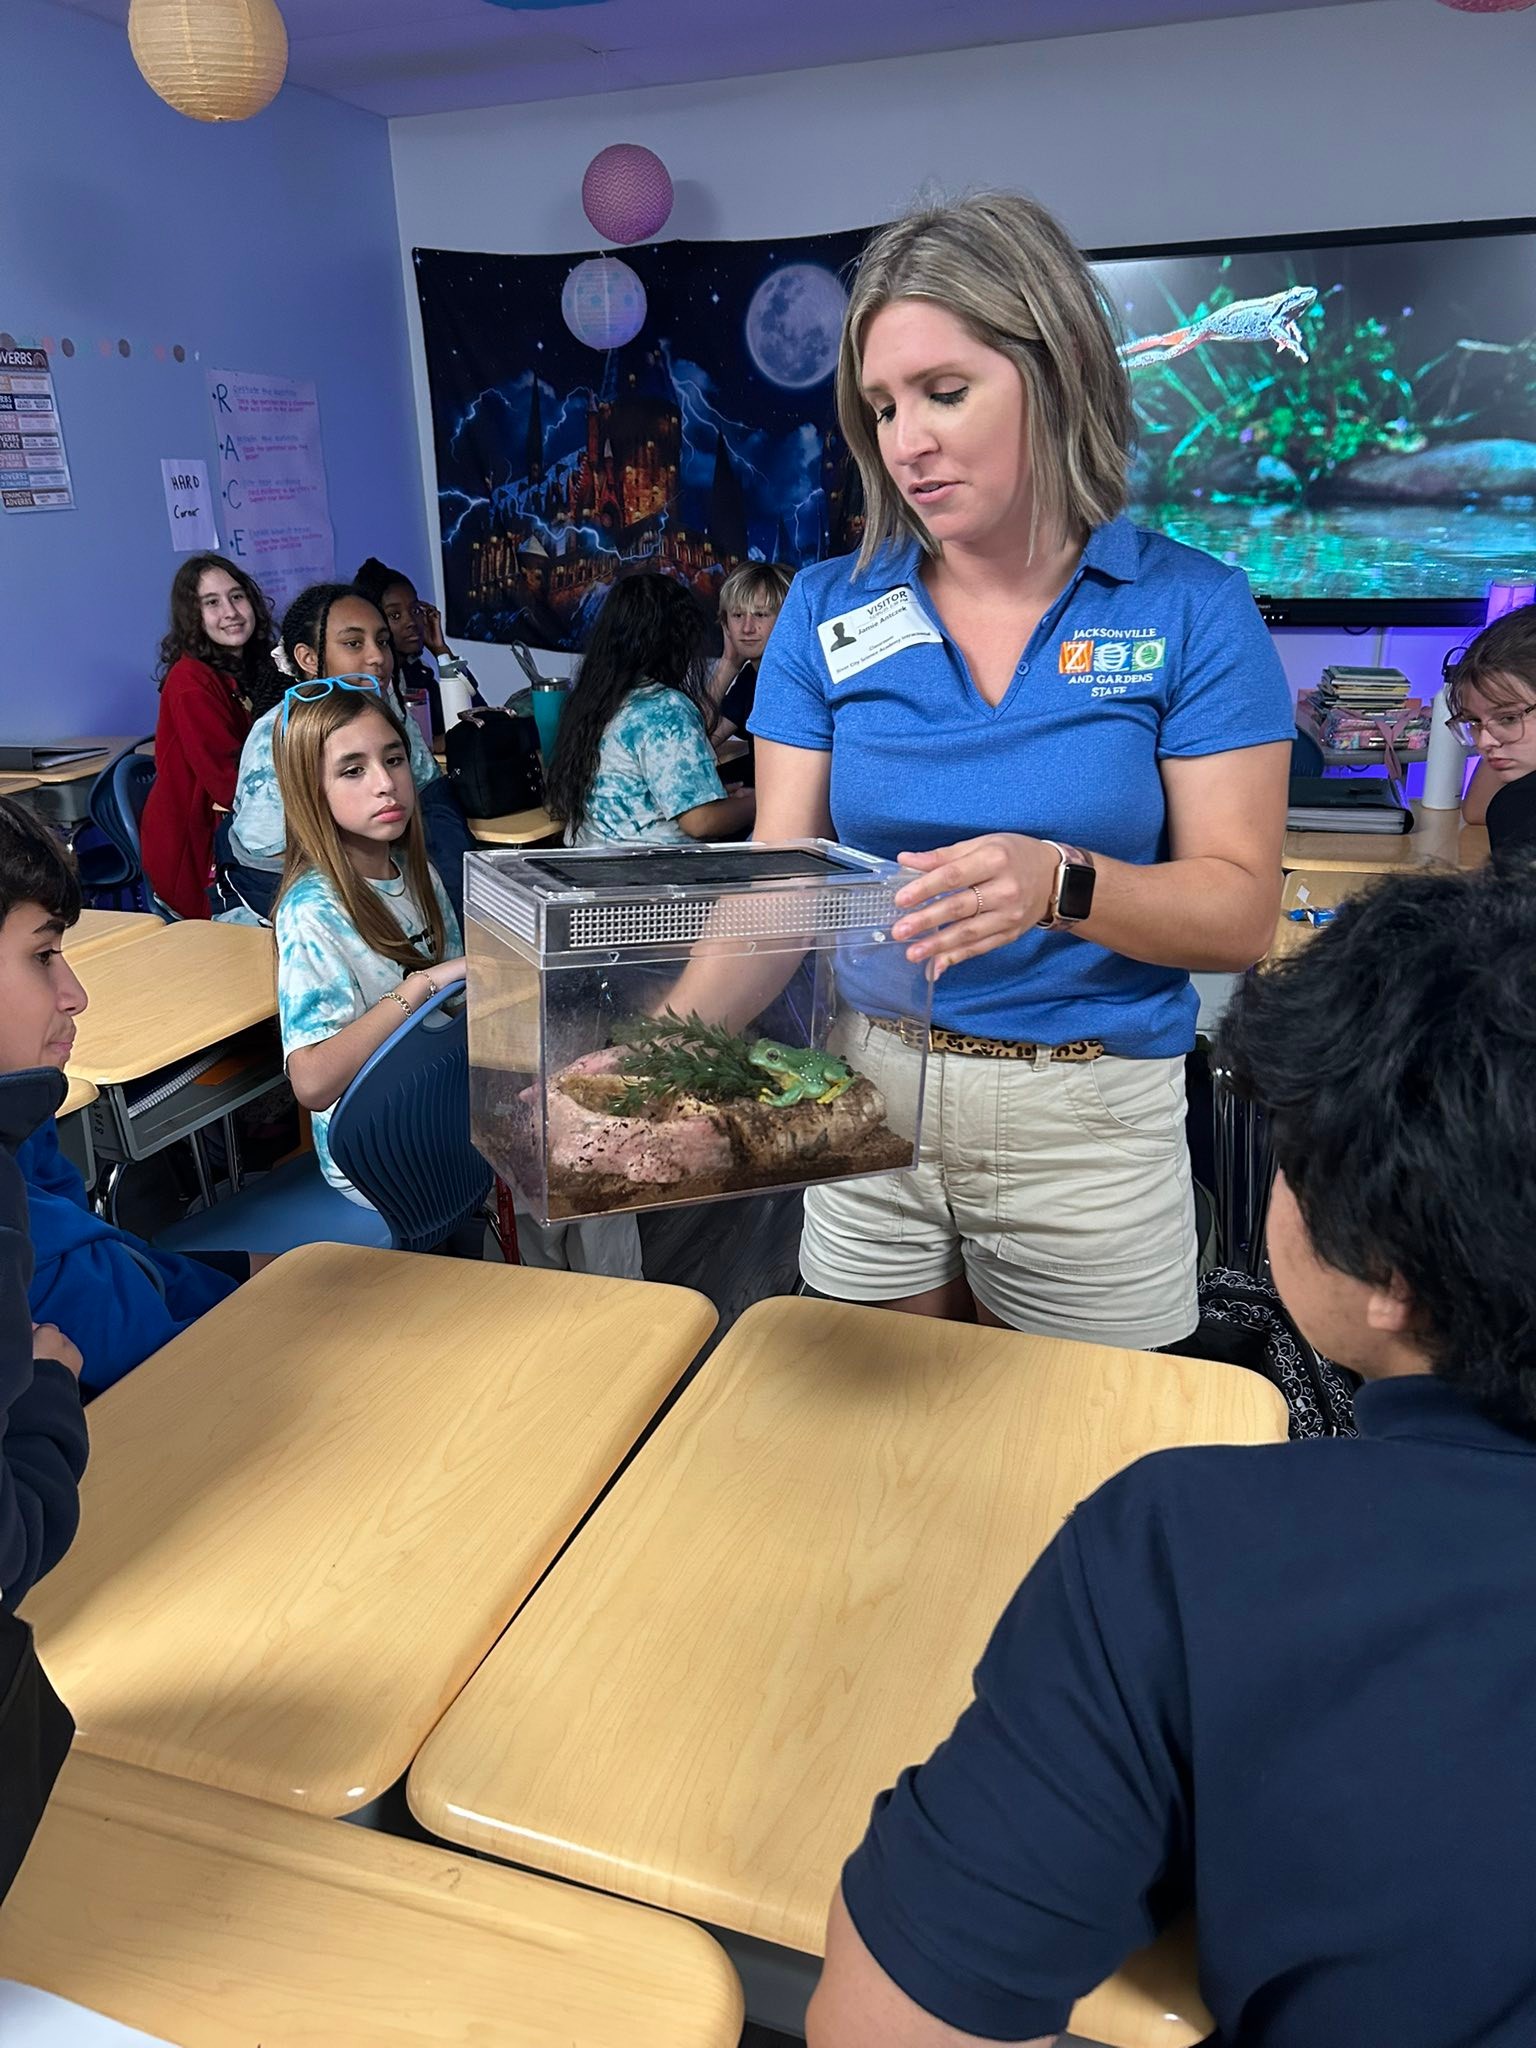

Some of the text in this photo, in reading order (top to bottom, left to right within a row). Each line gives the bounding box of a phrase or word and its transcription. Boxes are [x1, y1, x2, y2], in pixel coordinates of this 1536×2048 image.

[0, 351, 33, 366] VERBS
[216, 383, 232, 413] R
[224, 434, 240, 461] A
[170, 475, 200, 491] HARD
[226, 479, 242, 509] C
[173, 504, 200, 519] Corner
[233, 529, 246, 556] E
[867, 590, 908, 616] VISITOR
[858, 621, 878, 635] Jamie
[1073, 628, 1157, 641] JACKSONVILLE
[1062, 640, 1165, 672] ZOO
[1068, 673, 1153, 685] AND GARDENS
[1090, 686, 1128, 698] STAFF
